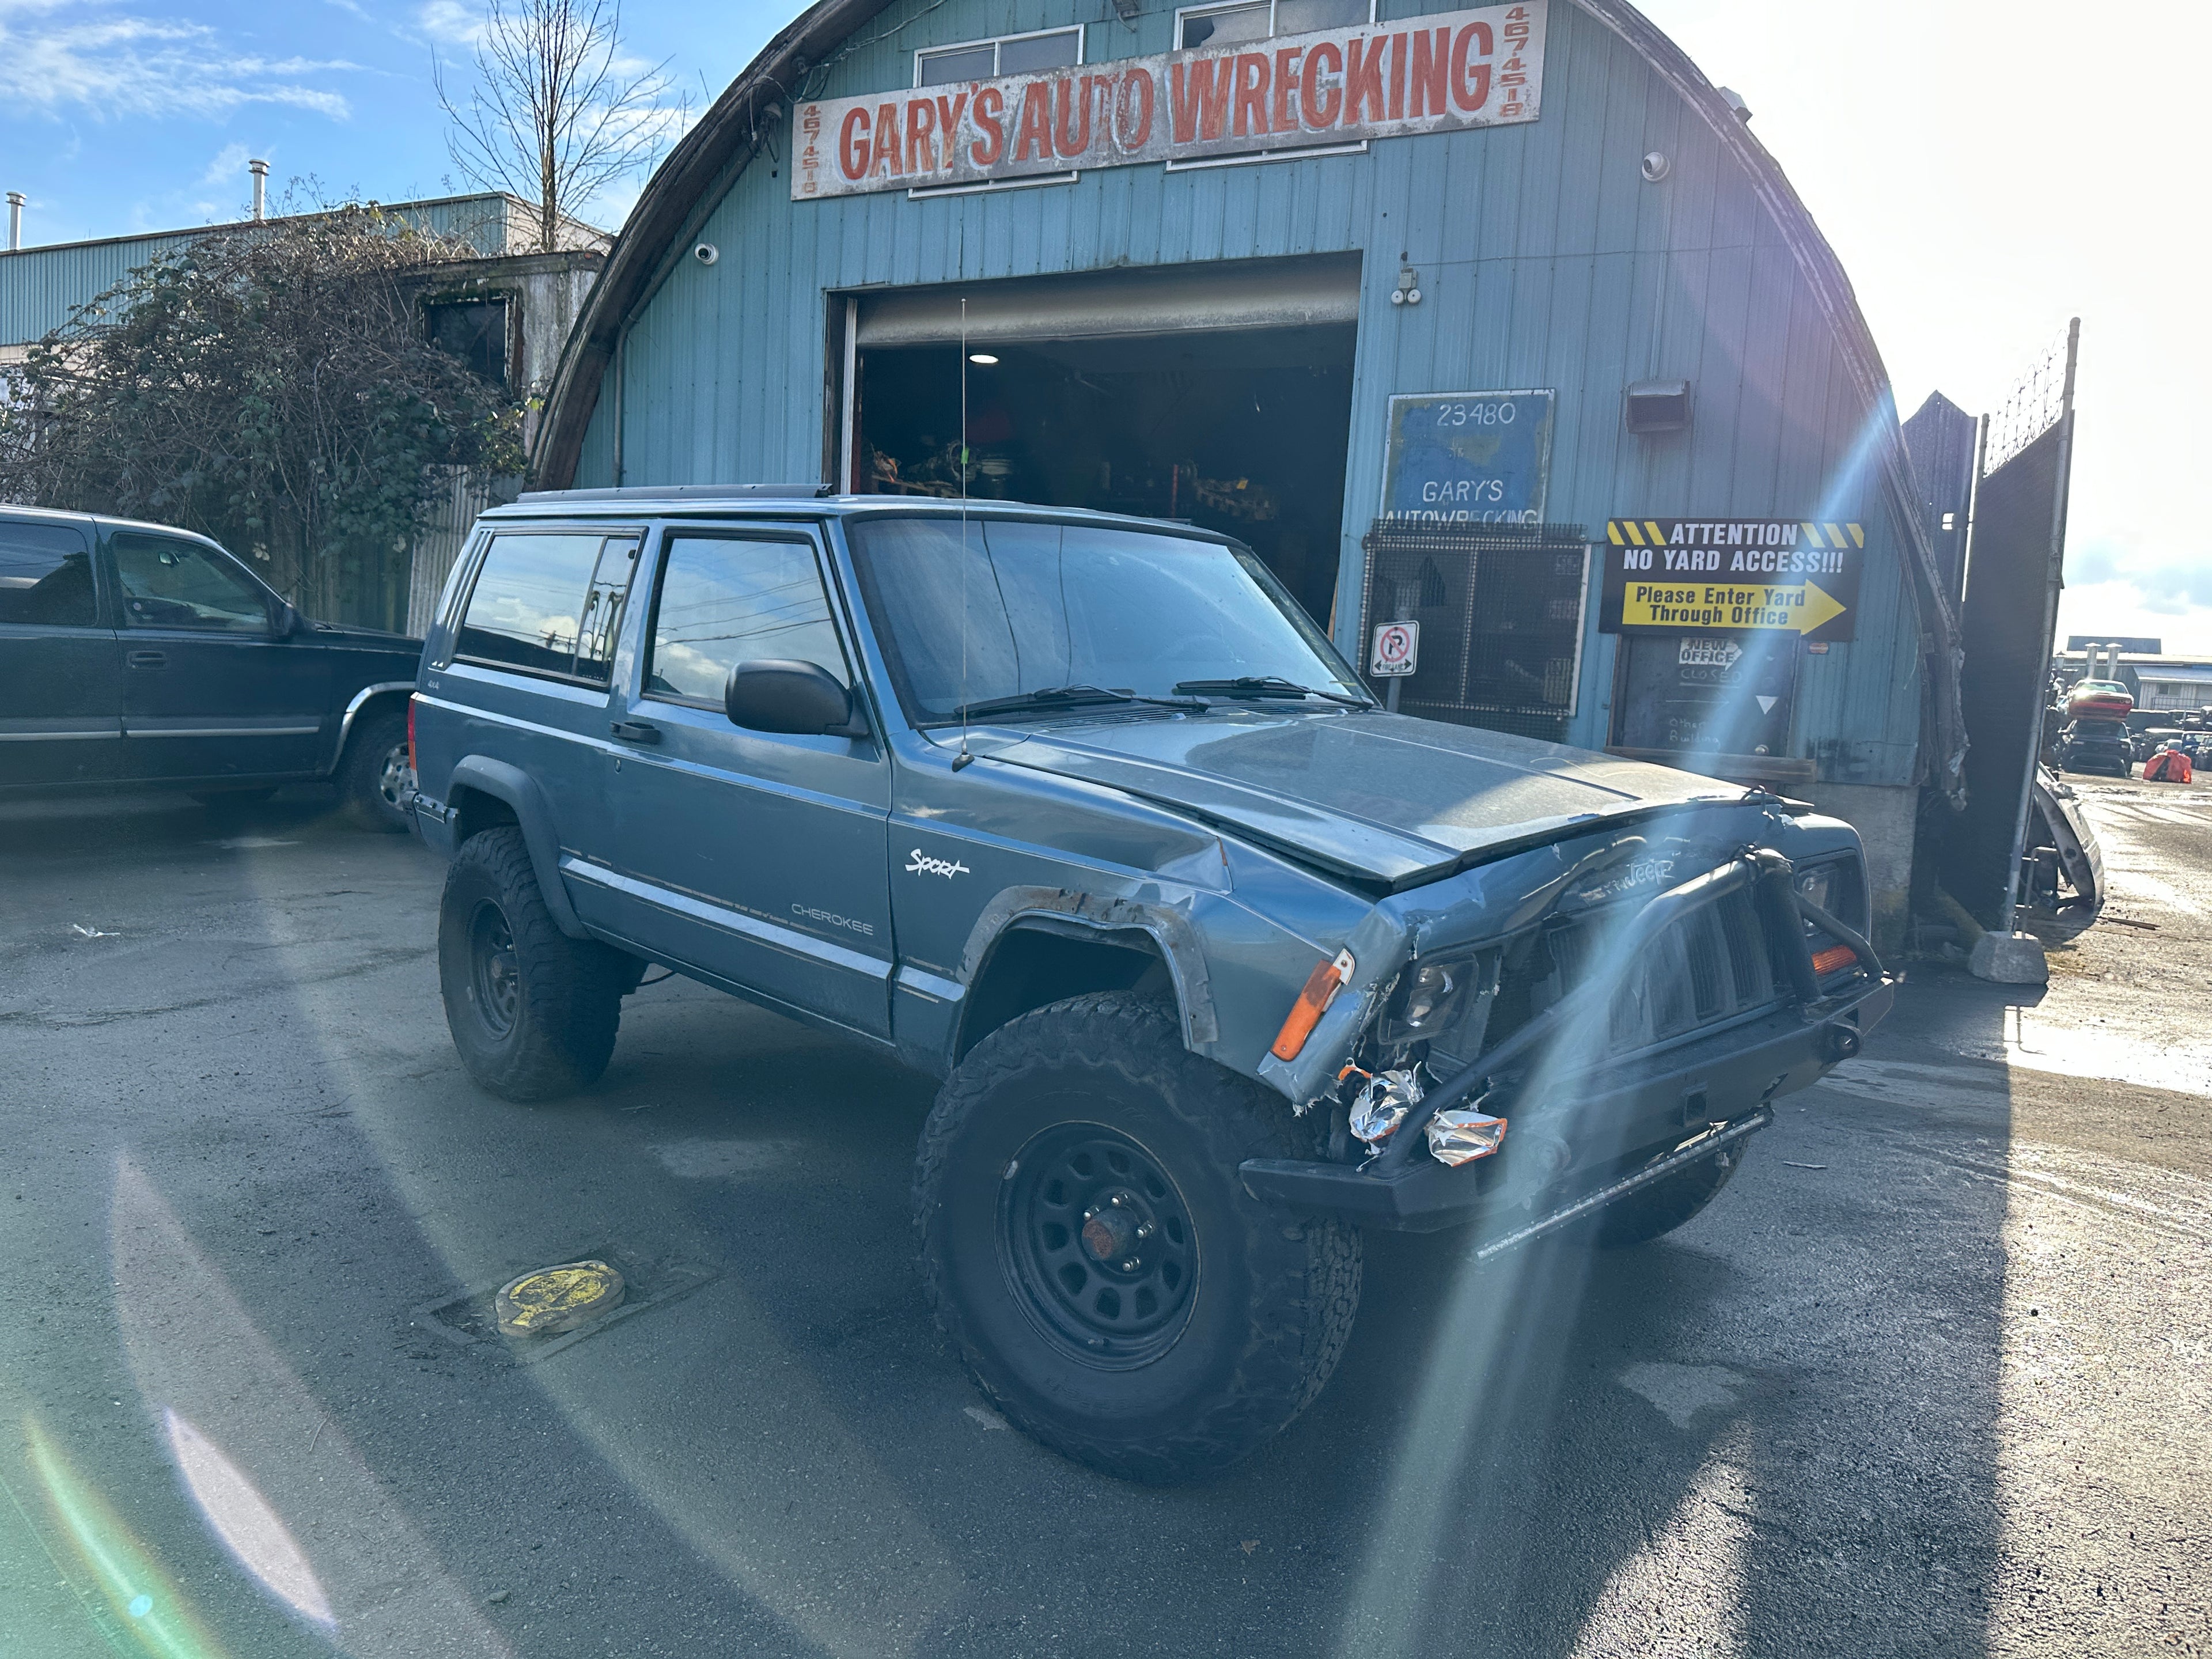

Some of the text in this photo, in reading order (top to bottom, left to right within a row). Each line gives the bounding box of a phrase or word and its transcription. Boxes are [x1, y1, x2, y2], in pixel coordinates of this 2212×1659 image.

[839, 21, 1494, 180] GARY'S AUTO WRECKING
[1437, 403, 1516, 426] 23480
[1423, 480, 1503, 502] GARY'S
[1670, 523, 1798, 545] ATTENTION
[1623, 550, 1843, 573] NO YARD ACCESS!!!
[1636, 586, 1805, 607] Please Enter Yard
[1650, 605, 1789, 625] Through Office
[1688, 640, 1726, 650] NEW
[1681, 650, 1735, 663] OFFICE
[1681, 668, 1743, 683] CLOSED
[1624, 862, 1666, 887] Jeep
[791, 903, 873, 935] CHEROKEE
